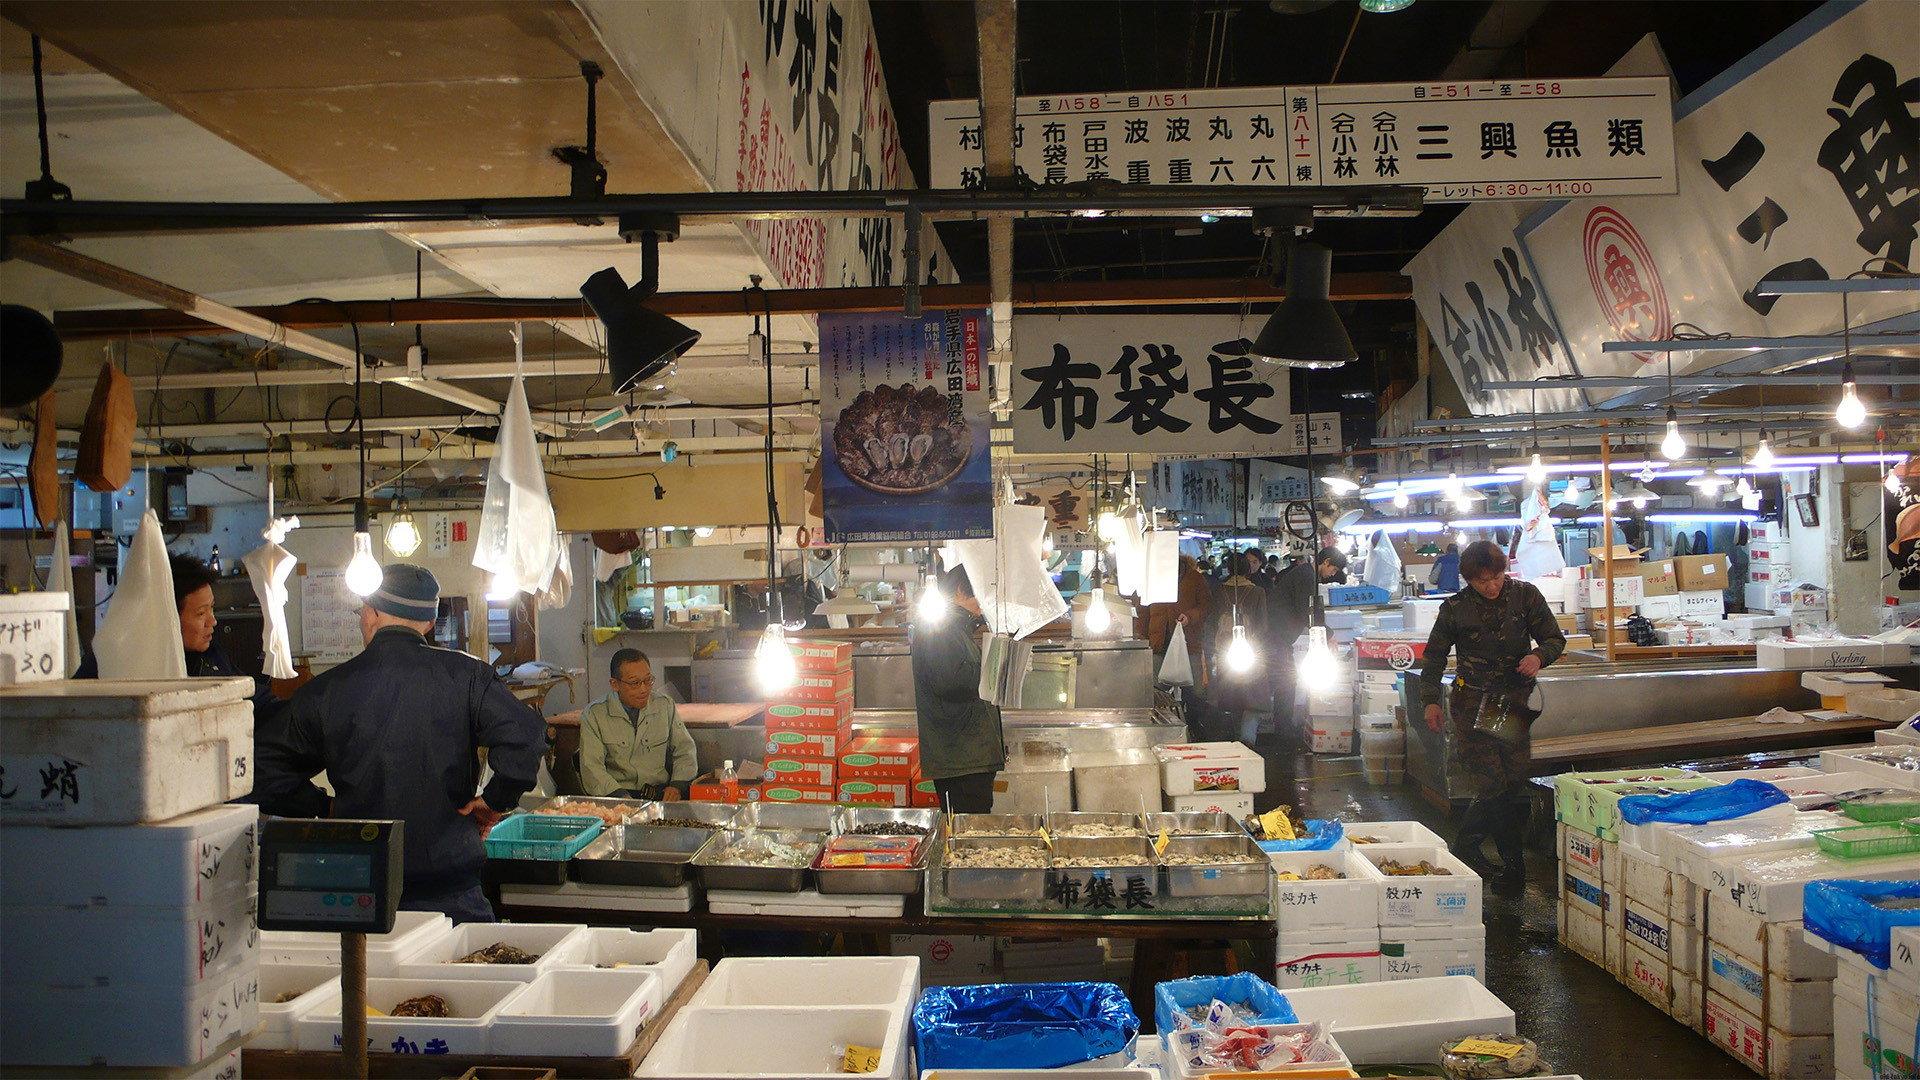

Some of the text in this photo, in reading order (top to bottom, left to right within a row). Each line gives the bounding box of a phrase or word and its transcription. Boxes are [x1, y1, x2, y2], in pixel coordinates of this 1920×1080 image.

[1208, 115, 1234, 182] 丸六
[1250, 113, 1276, 181] 丸六
[1291, 96, 1314, 182] 第八十一棟
[1416, 118, 1647, 160] 三興魚類
[1019, 337, 1283, 442] 布袋長
[1824, 650, 1867, 667] Sterling
[234, 756, 247, 778] 25
